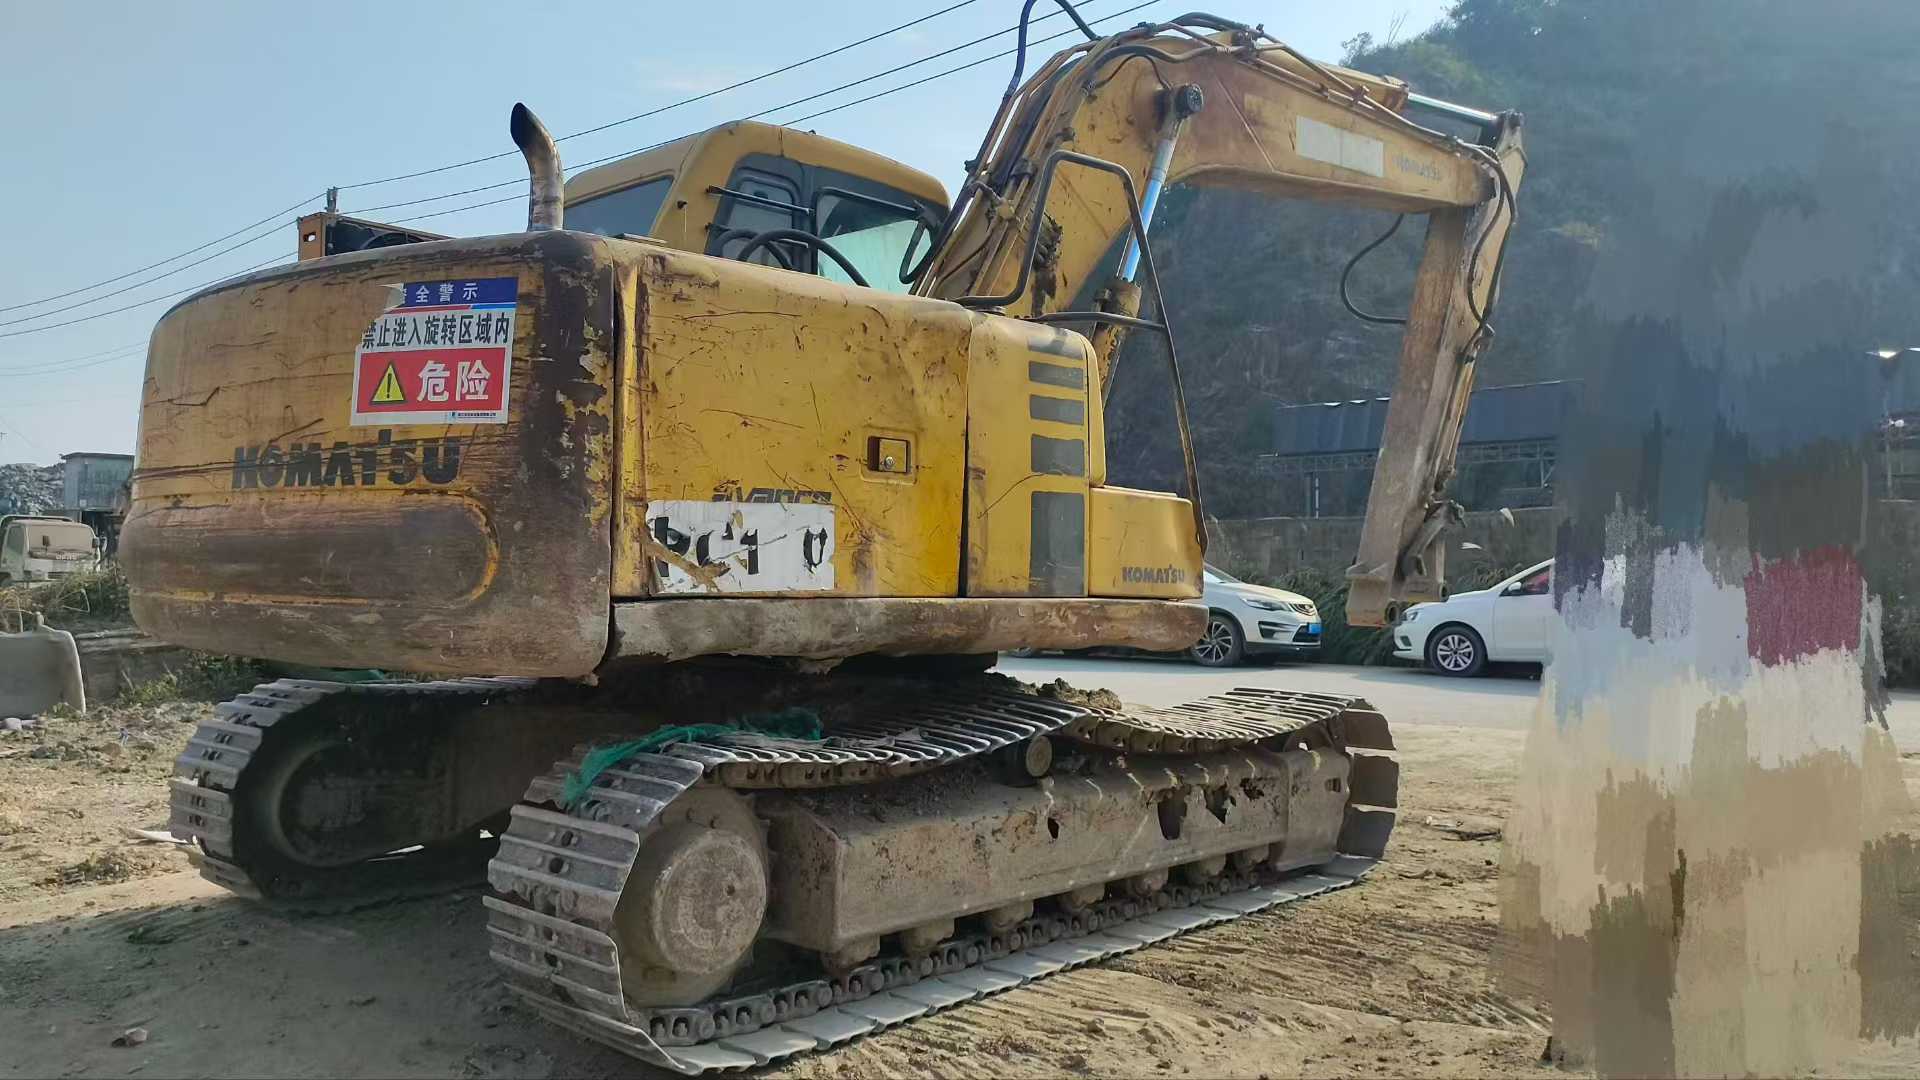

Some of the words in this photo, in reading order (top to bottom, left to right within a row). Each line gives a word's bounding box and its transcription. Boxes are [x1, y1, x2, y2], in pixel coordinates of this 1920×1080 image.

[362, 312, 509, 349] 禁止进入旋转区域内
[417, 359, 491, 402] 危险
[1122, 564, 1185, 584] KOMATSU
